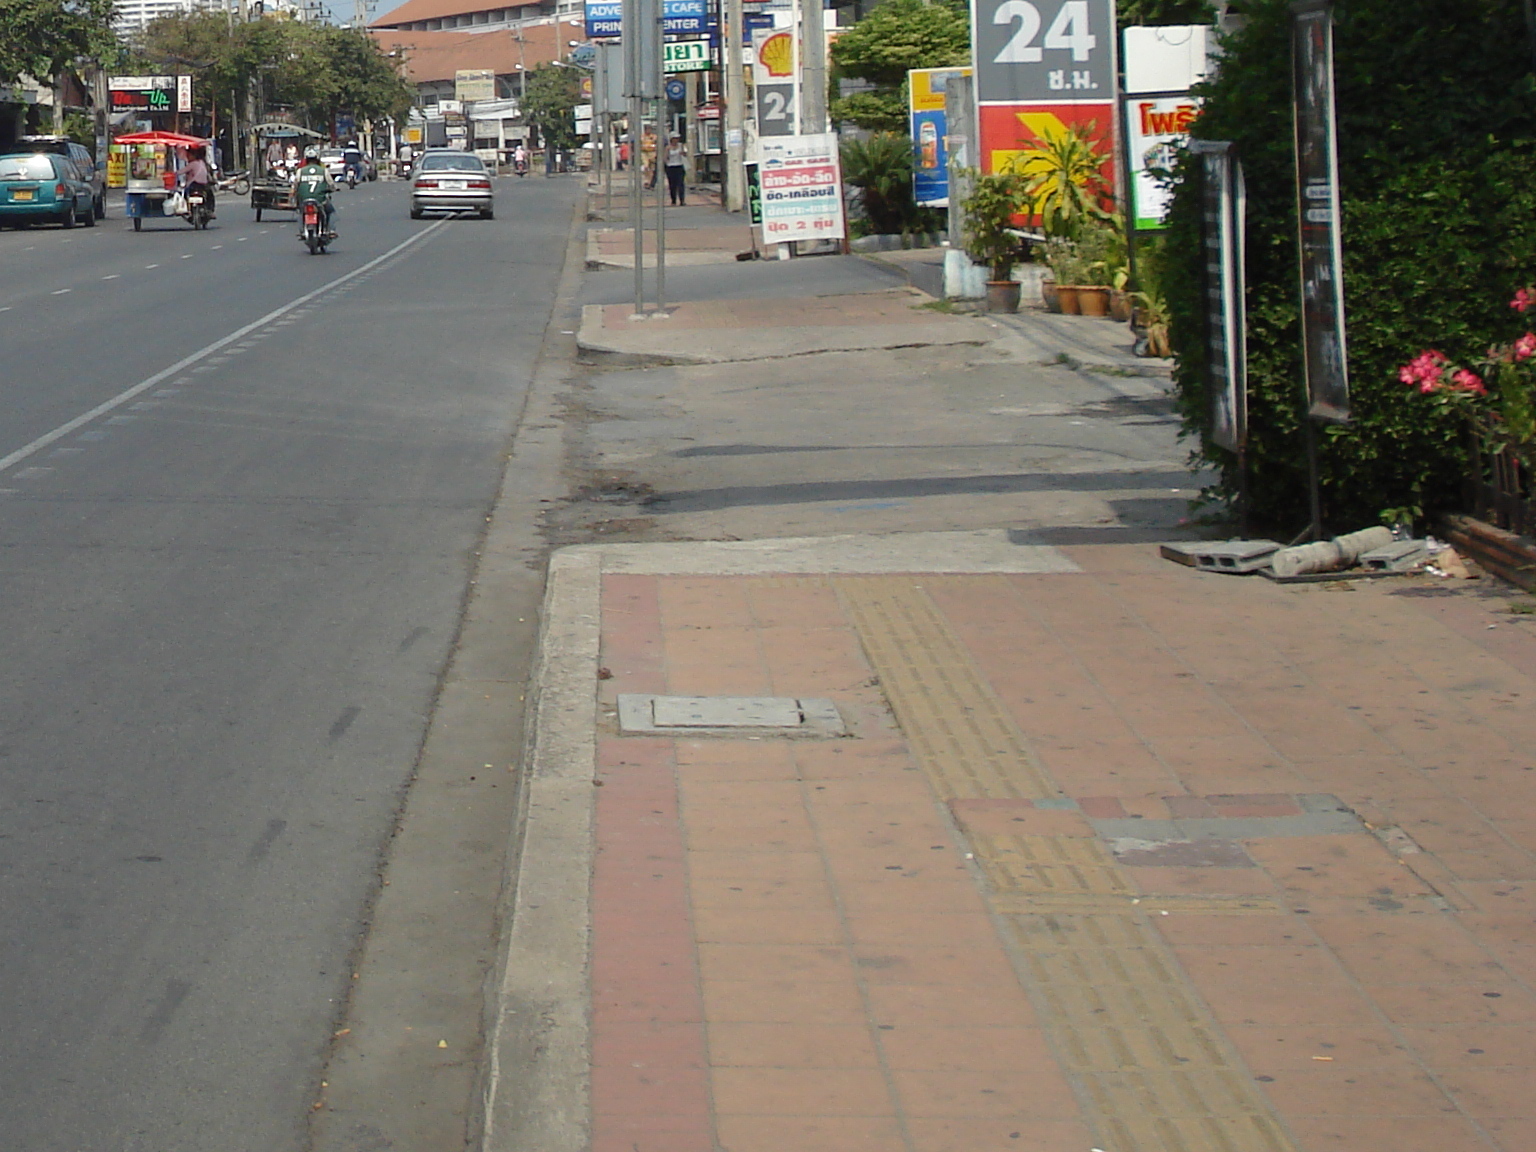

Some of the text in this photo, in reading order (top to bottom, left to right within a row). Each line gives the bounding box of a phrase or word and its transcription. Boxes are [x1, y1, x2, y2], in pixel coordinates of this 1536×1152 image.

[671, 2, 703, 13] CAFE
[308, 181, 318, 193] 7
[795, 220, 807, 230] 2
